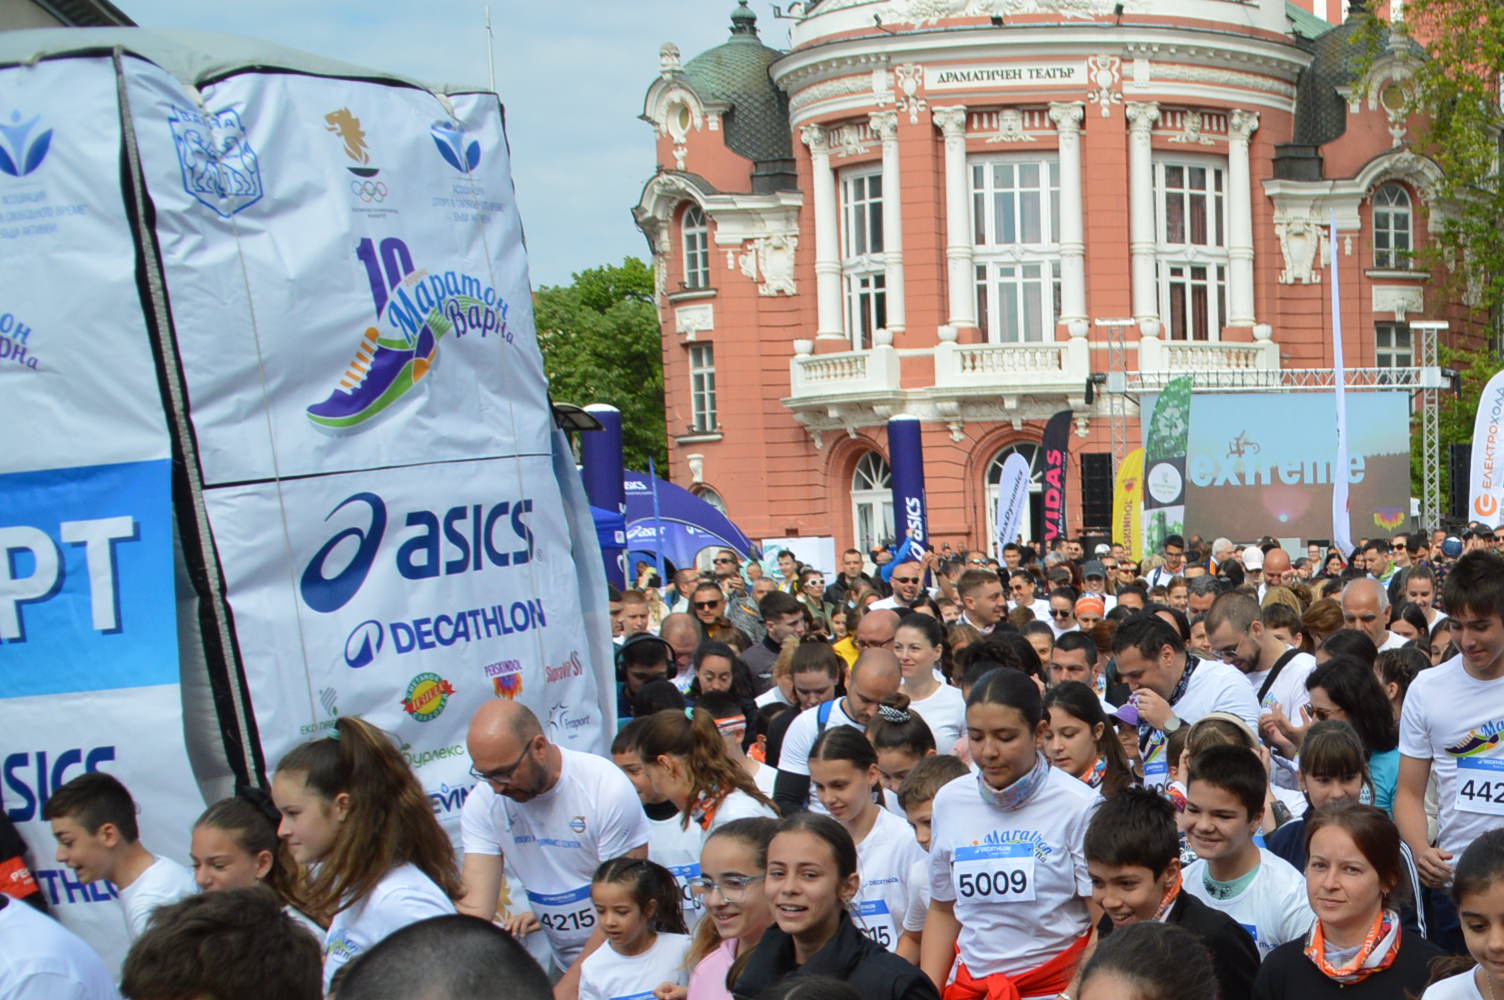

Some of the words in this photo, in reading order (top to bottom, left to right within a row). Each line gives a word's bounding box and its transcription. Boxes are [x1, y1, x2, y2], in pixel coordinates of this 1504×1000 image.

[937, 67, 1022, 84] ДРАМАТИЧЕН
[1027, 67, 1075, 80] ТЕАТЪР
[355, 236, 416, 321] 10
[387, 270, 509, 345] Маратон
[445, 298, 514, 345] Варна
[396, 499, 533, 582] asics
[0, 516, 140, 644] РТ
[390, 598, 547, 655] DECATHLON
[959, 869, 1027, 898] 5009
[541, 908, 595, 931] 4215
